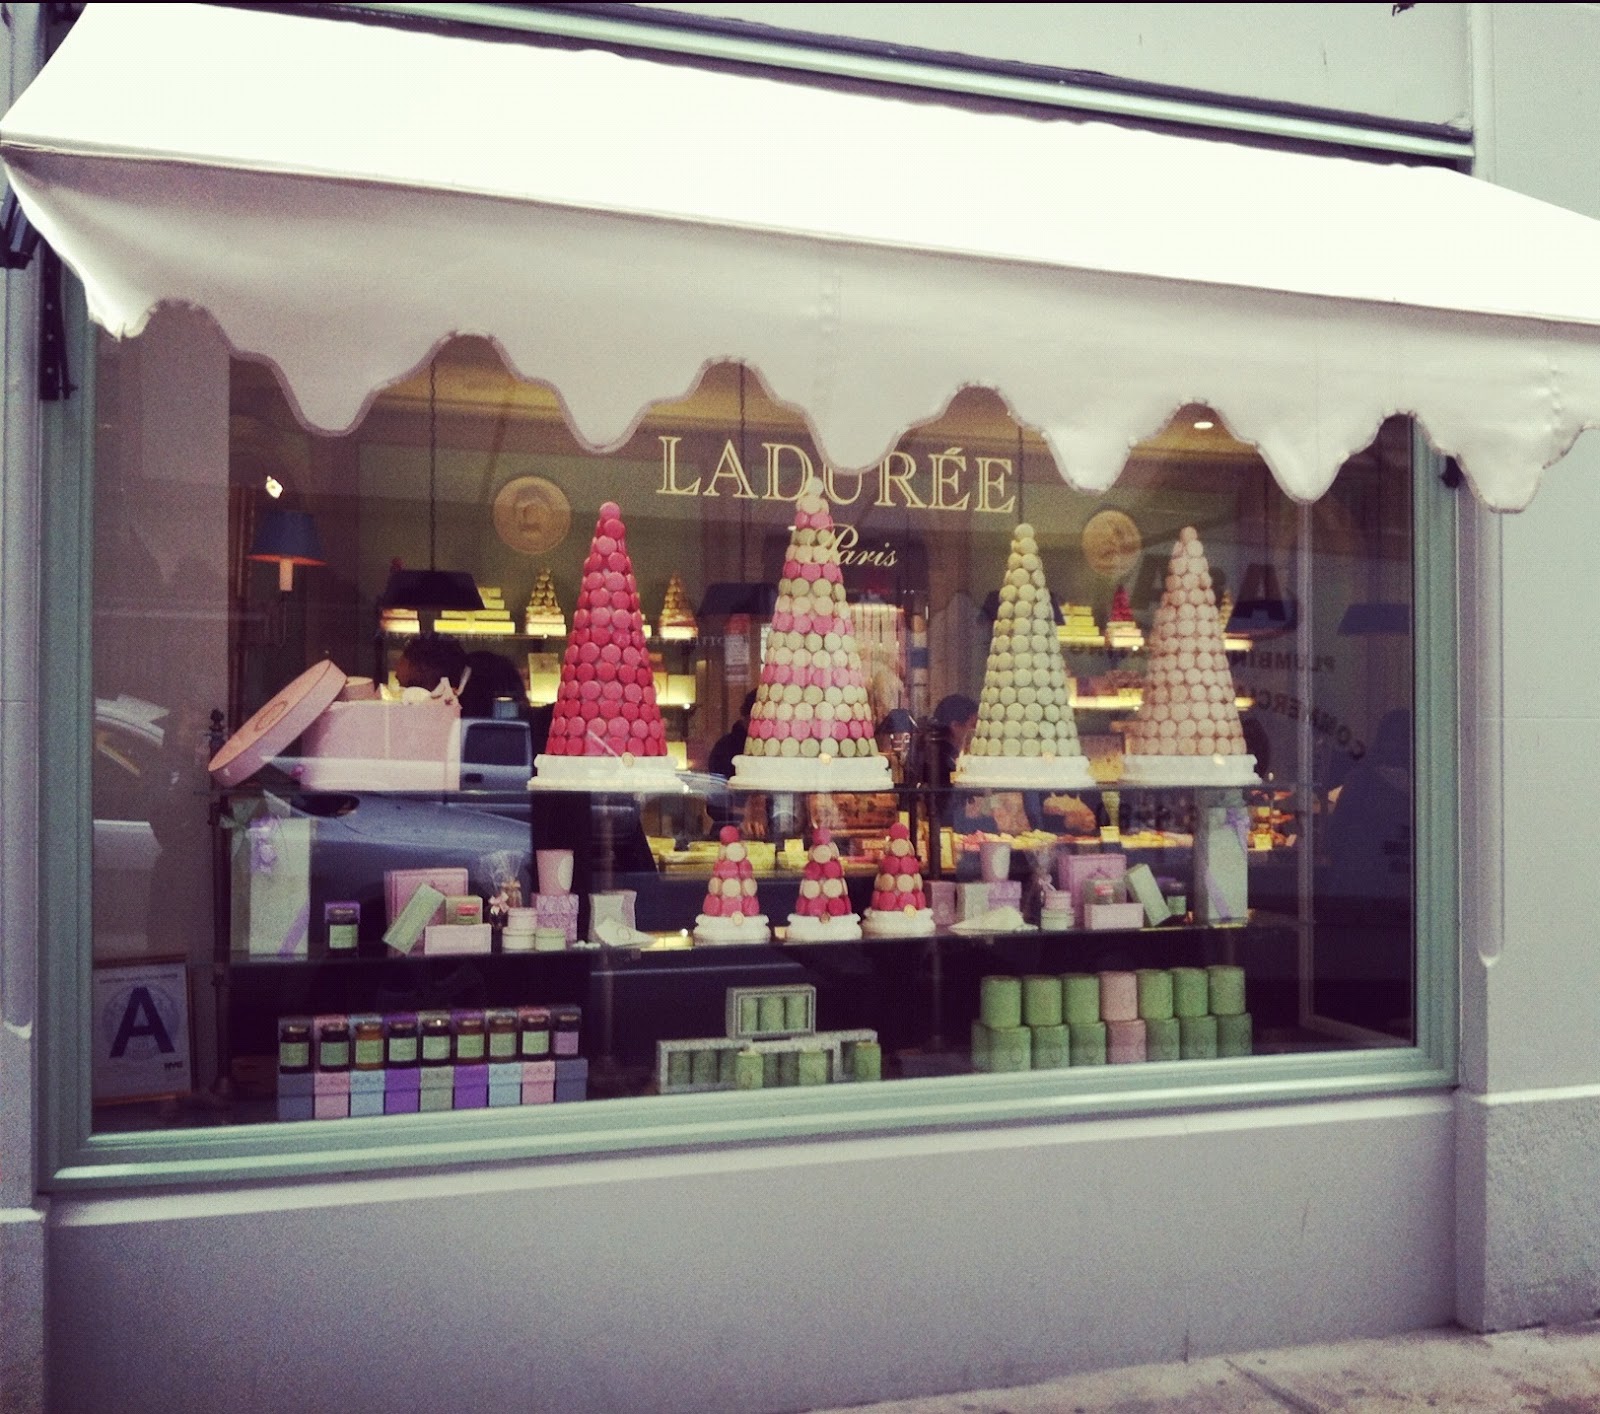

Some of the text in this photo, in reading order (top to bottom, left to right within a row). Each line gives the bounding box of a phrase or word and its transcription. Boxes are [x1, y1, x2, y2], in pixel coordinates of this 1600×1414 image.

[655, 435, 1017, 514] LADURÉE
[807, 522, 898, 568] Paris
[108, 985, 176, 1059] A
